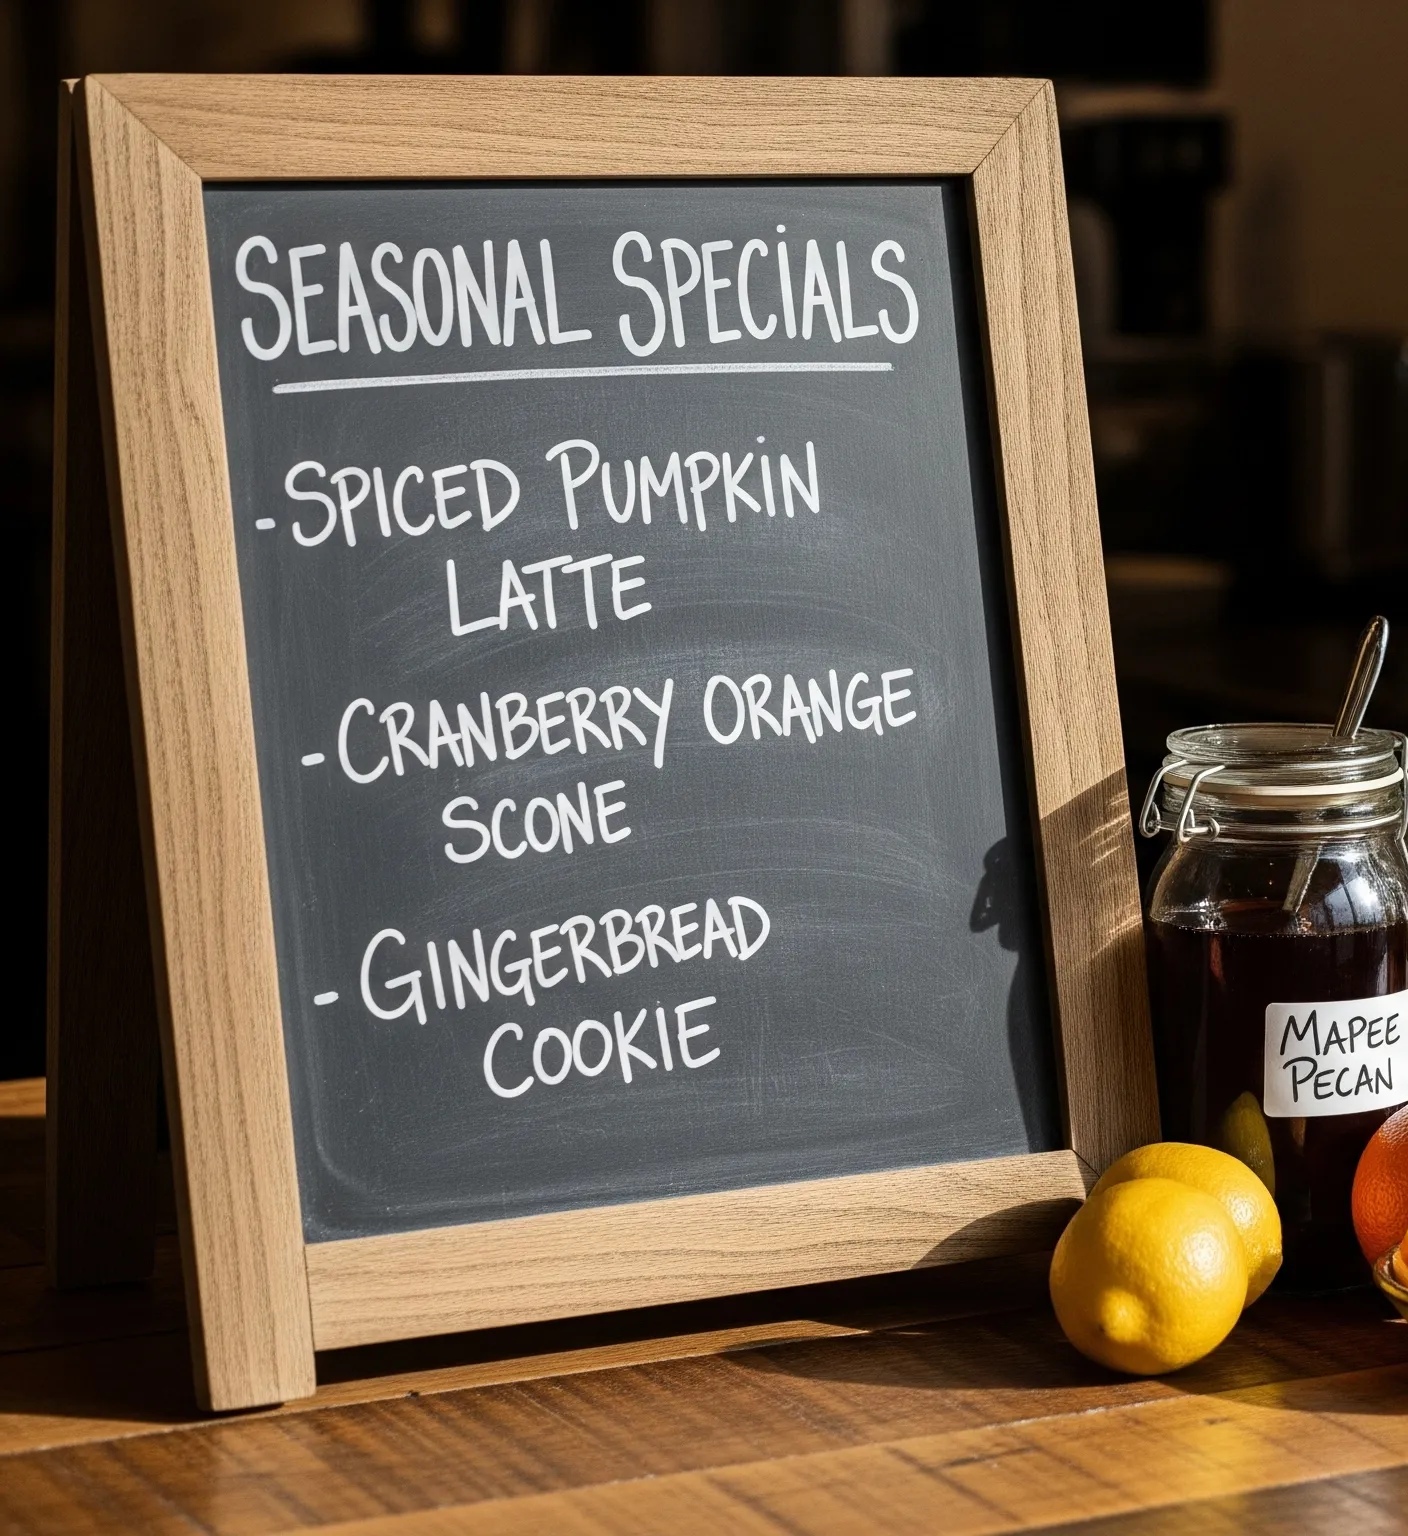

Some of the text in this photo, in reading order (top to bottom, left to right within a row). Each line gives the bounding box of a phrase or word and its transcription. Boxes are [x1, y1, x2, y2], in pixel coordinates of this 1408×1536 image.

[236, 236, 592, 360] SEASONAL
[447, 554, 652, 636] LATTE
[704, 668, 916, 744] ORANGE
[442, 780, 631, 863] SCONE
[483, 996, 721, 1098] COOKIE
[1279, 1011, 1401, 1057] MAPEE
[1282, 1056, 1393, 1102] PECAN
